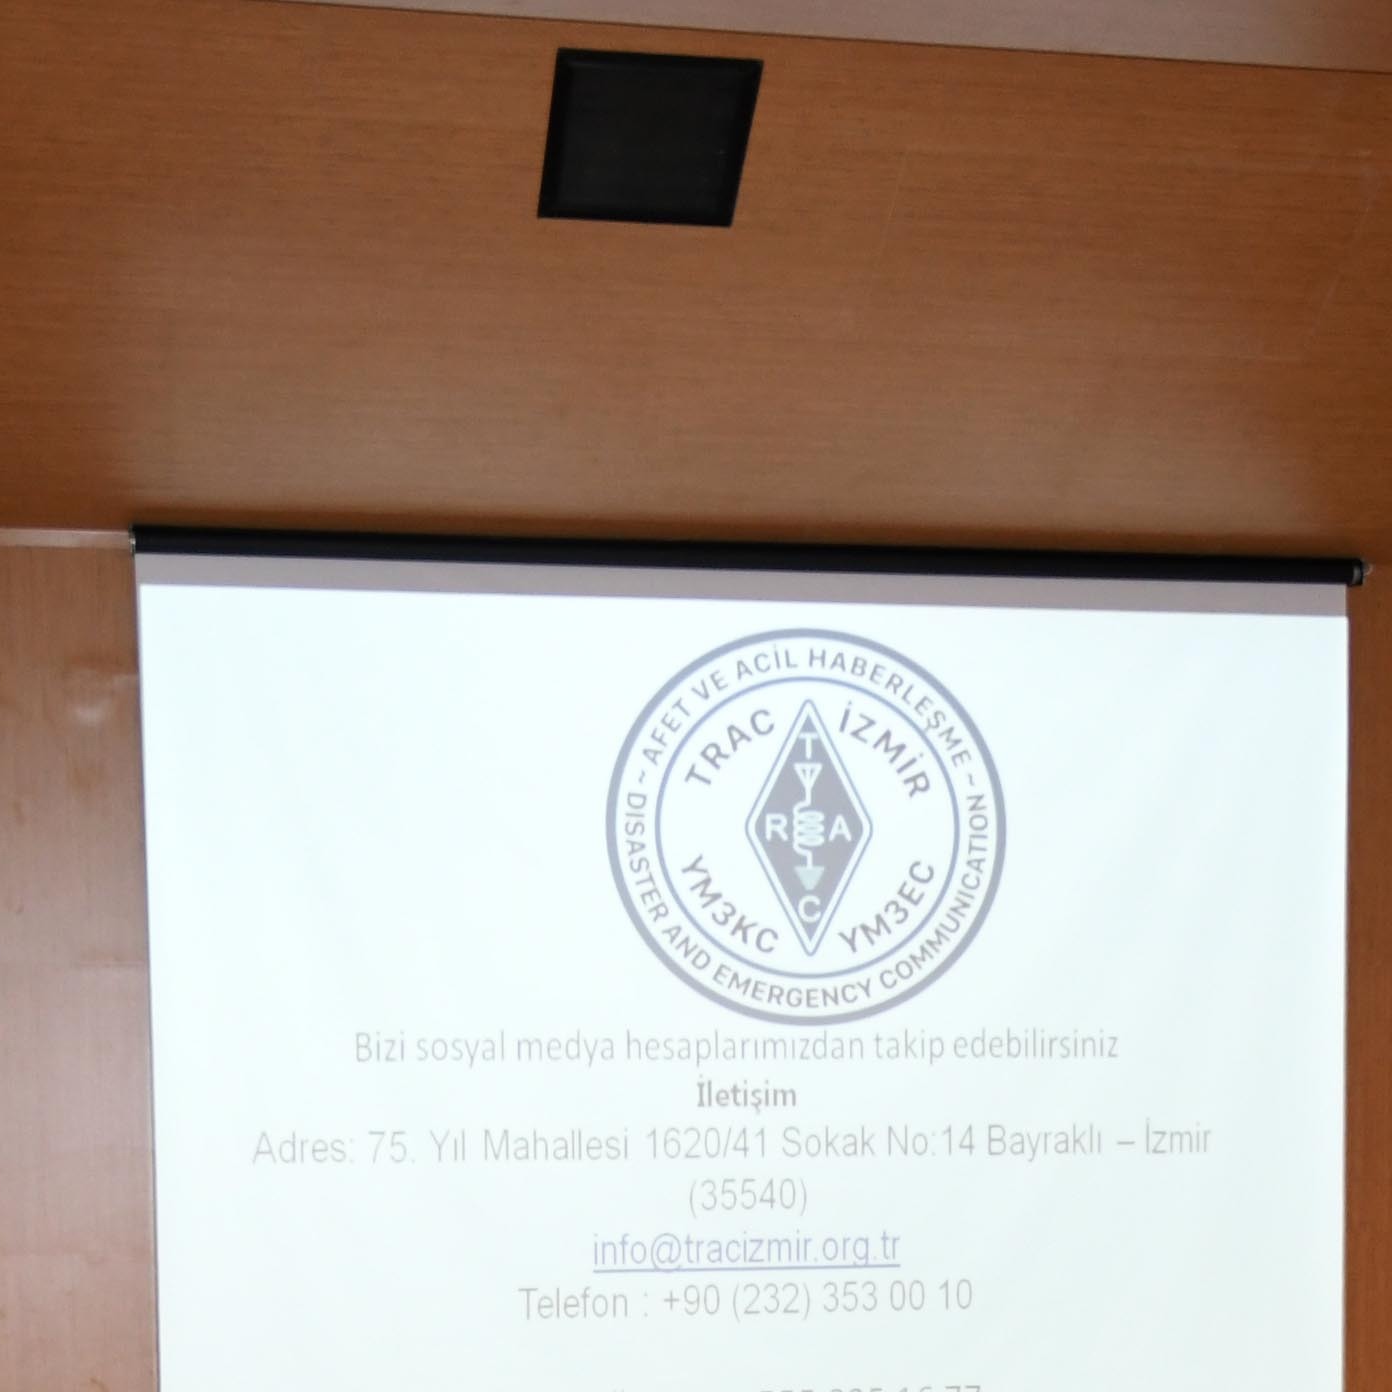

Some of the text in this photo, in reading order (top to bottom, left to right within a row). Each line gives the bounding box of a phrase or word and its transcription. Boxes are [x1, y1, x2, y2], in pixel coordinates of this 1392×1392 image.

[643, 643, 971, 768] AFET VE ACİL HABERLEŞME
[685, 699, 931, 798] TRAC İZMİR
[624, 792, 988, 1009] DISASTER AND EMERGENCY COMMUNICATION
[680, 854, 935, 954] YM3KC YM3EC
[355, 1028, 1120, 1069] Bizi sosyal medya hesaplarımızdan takip edebilirsiniz
[696, 1076, 797, 1112] İletişim
[252, 1131, 355, 1164] Adres:
[368, 1130, 415, 1163] 75.
[428, 1129, 466, 1162] Yıl
[483, 1128, 628, 1162] Mahallesi
[648, 1126, 767, 1160] 1620/41
[782, 1124, 875, 1159] Sokak
[887, 1124, 975, 1157] No:14
[987, 1123, 1102, 1163] Bayraklı
[1145, 1117, 1211, 1154] İzmir
[688, 1177, 808, 1218] (35540)
[592, 1230, 901, 1271] info@tracizmir.org.tr
[518, 1287, 629, 1320] Telefon
[663, 1283, 720, 1315] +90
[731, 1282, 811, 1321] (232)
[823, 1281, 878, 1313] 353
[889, 1280, 926, 1312] 00
[939, 1279, 974, 1310] 10
